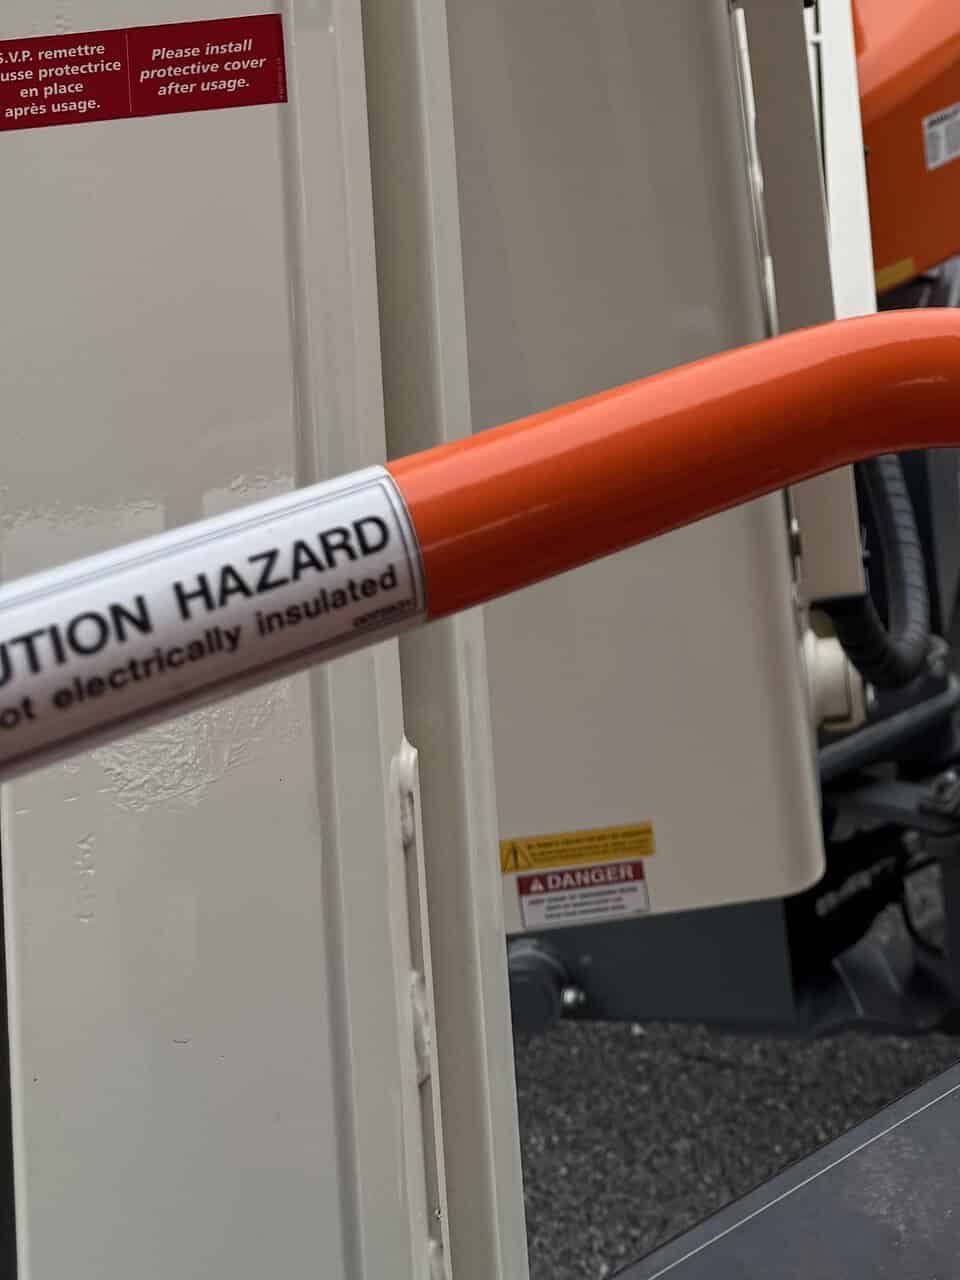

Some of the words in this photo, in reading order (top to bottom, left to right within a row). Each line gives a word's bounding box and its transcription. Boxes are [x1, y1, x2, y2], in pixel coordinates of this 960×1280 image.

[38, 44, 106, 61] remettre
[151, 47, 201, 61] Please
[205, 38, 253, 56] install
[38, 60, 122, 81] protectrice
[139, 61, 220, 83] protective
[223, 57, 267, 72] cover
[20, 87, 39, 98] en
[44, 82, 84, 99] place
[157, 82, 197, 97] after
[200, 78, 251, 92] usage.
[5, 103, 47, 120] après
[51, 99, 101, 113] usage.
[173, 516, 390, 620] HAZARD
[53, 624, 241, 708] electrically
[255, 563, 398, 637] insulated
[546, 863, 635, 889] DANGER
